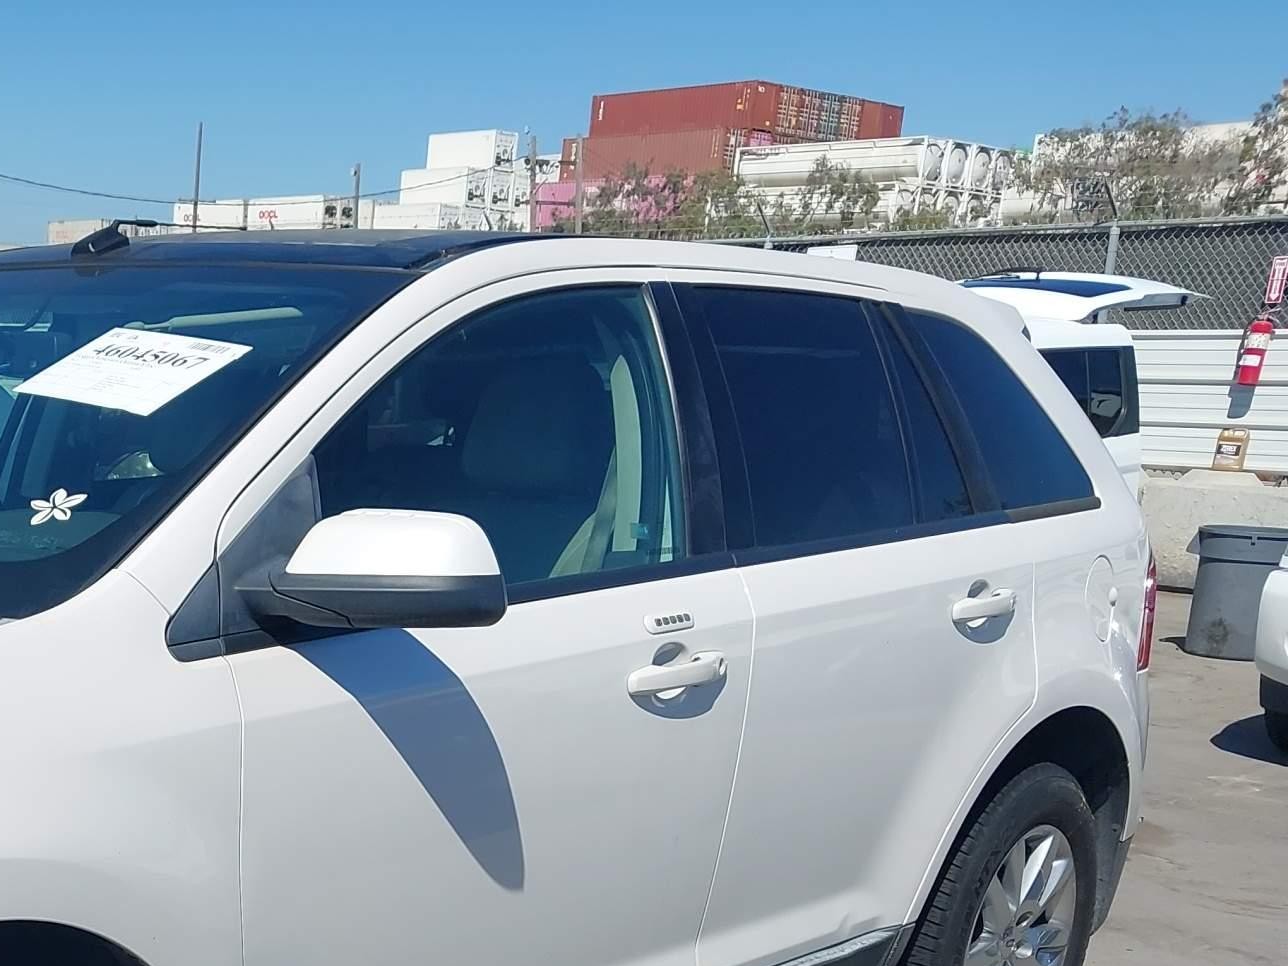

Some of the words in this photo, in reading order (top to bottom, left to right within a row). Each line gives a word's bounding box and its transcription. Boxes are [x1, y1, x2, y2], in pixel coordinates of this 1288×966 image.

[183, 213, 201, 222] OOL
[258, 209, 279, 219] OOCL
[93, 343, 210, 369] 46045067
